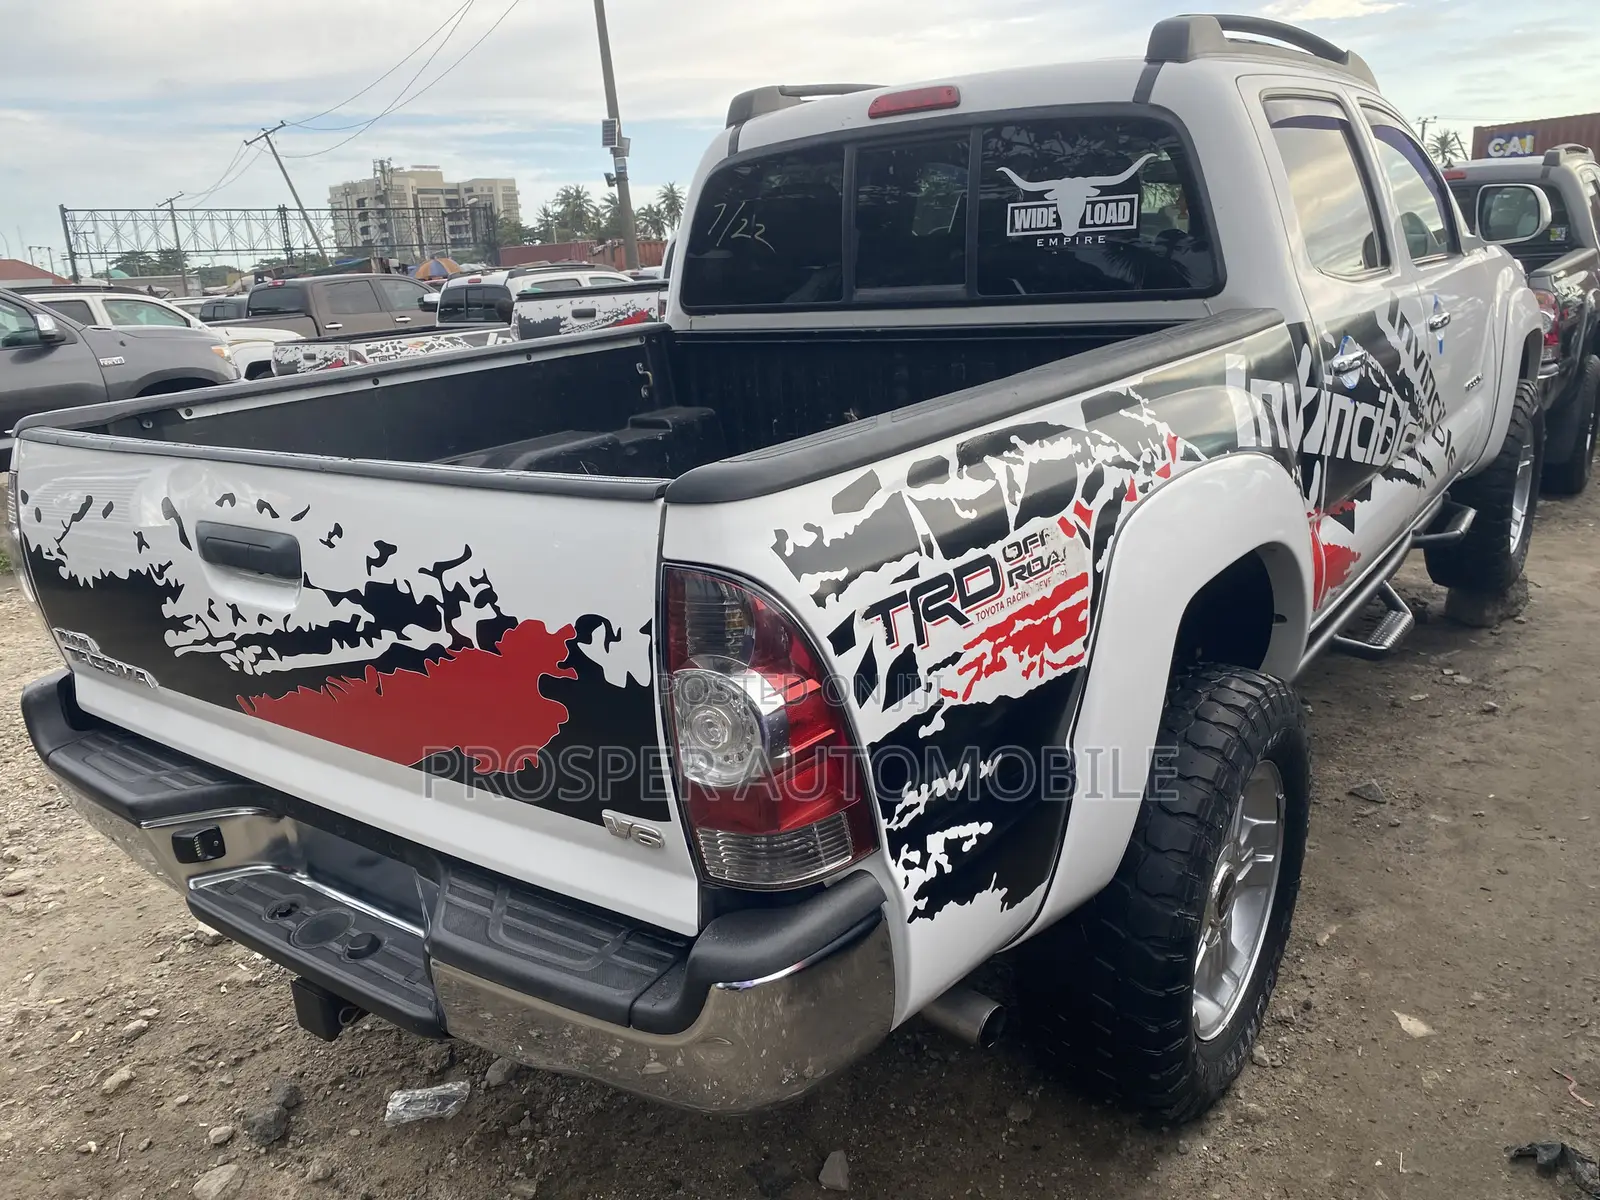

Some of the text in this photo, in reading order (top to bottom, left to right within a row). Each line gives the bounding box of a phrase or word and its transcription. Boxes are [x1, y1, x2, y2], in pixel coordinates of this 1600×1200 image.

[1488, 135, 1534, 157] CAI
[1013, 201, 1131, 230] WIDE LOAD
[1037, 235, 1106, 247] EMPIRE
[861, 554, 1006, 650] TRD
[975, 602, 1005, 622] TOYOTA
[602, 810, 665, 848] V6
